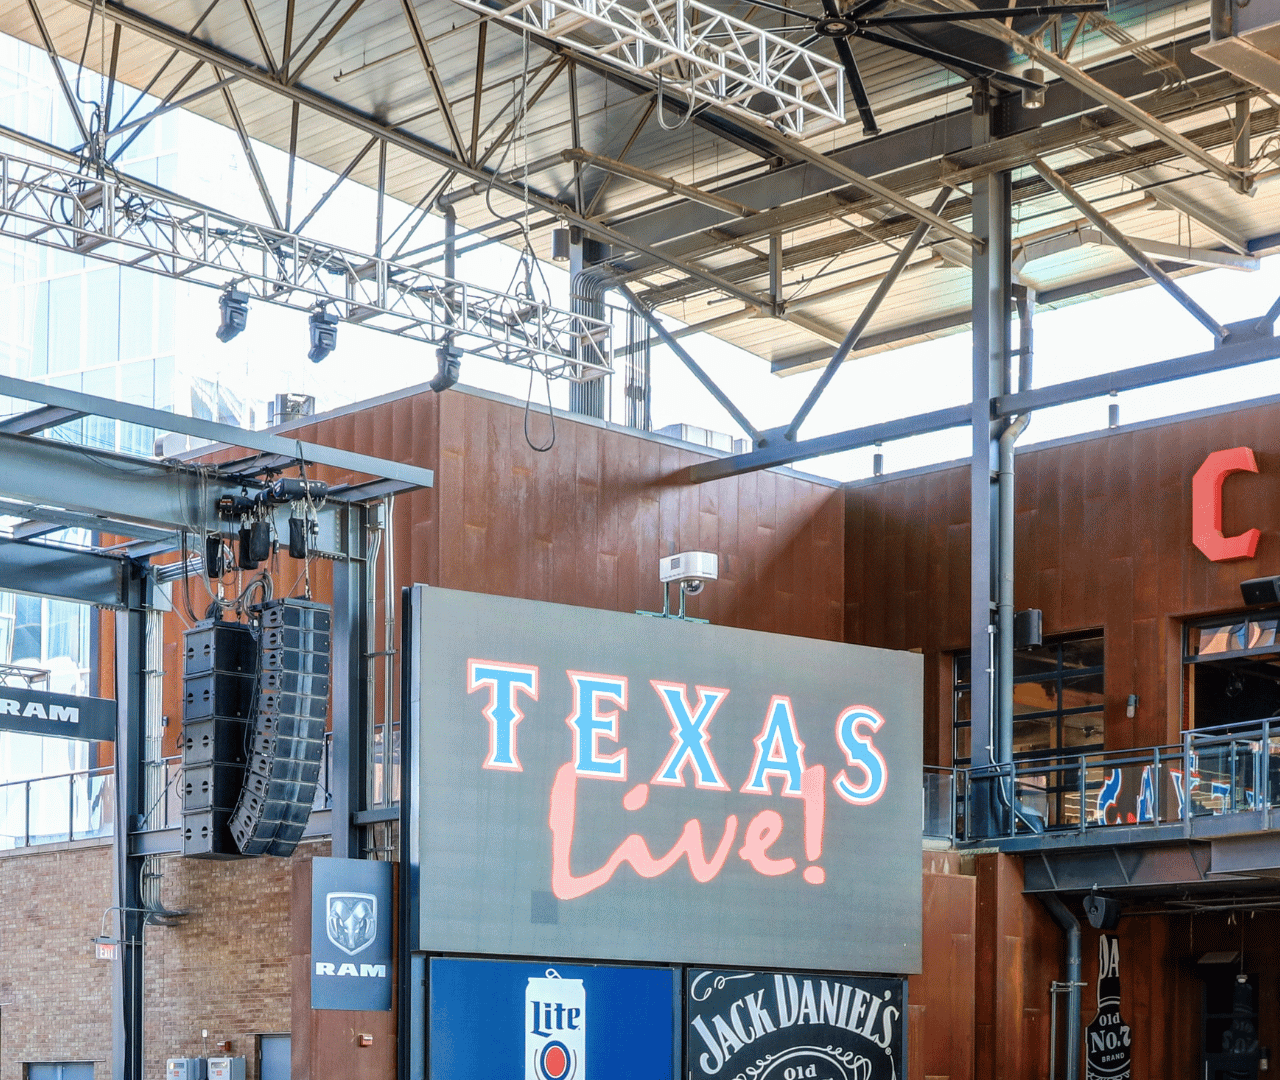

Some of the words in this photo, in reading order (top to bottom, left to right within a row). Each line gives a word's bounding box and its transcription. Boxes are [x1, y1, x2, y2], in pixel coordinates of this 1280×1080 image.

[467, 658, 888, 806] TEXAS
[548, 761, 826, 900] Live!
[315, 961, 387, 978] RAM
[530, 1000, 581, 1038] Lite
[690, 988, 778, 1075] JACK
[1101, 1052, 1125, 1063] BRAND
